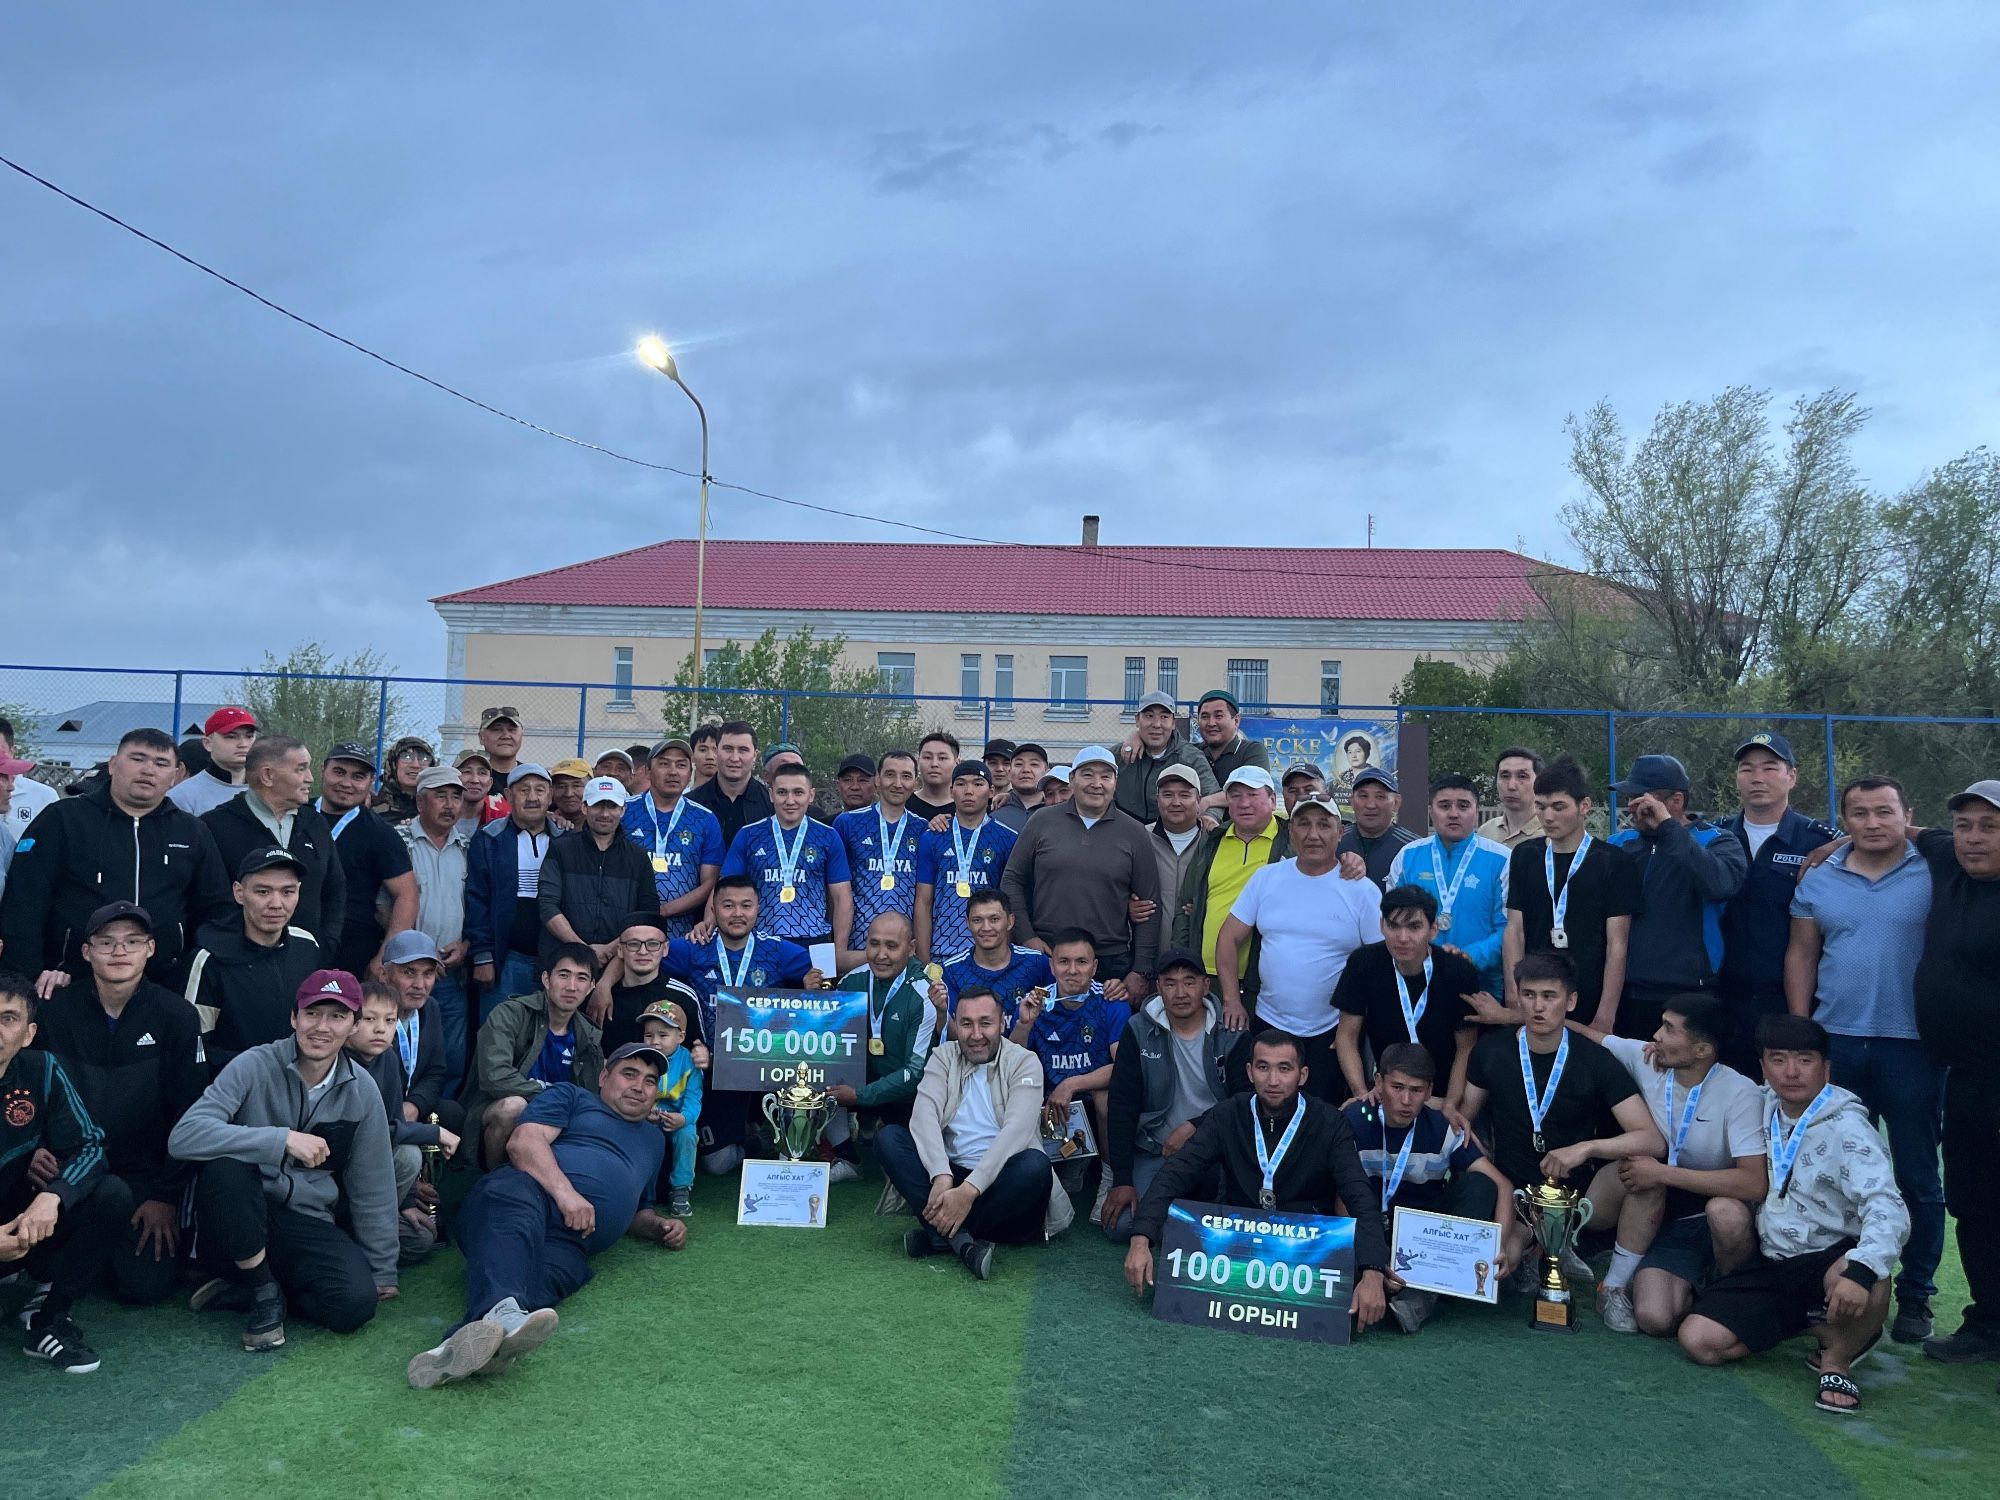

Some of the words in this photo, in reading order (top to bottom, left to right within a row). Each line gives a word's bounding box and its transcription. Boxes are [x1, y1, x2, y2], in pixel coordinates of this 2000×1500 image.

[1263, 737, 1321, 755] ЕСКЕ
[868, 858, 912, 873] DAYA
[946, 870, 988, 885] DAYA
[746, 997, 839, 1011] СЕРТИФИКАТ
[720, 1027, 773, 1054] 150
[1052, 1052, 1092, 1070] DARYA
[1201, 1214, 1319, 1240] СЕРТИФИКАТ
[1453, 1232, 1470, 1241] ХАТ
[1167, 1248, 1231, 1285] 100
[1228, 1303, 1298, 1329] ОРЫН
